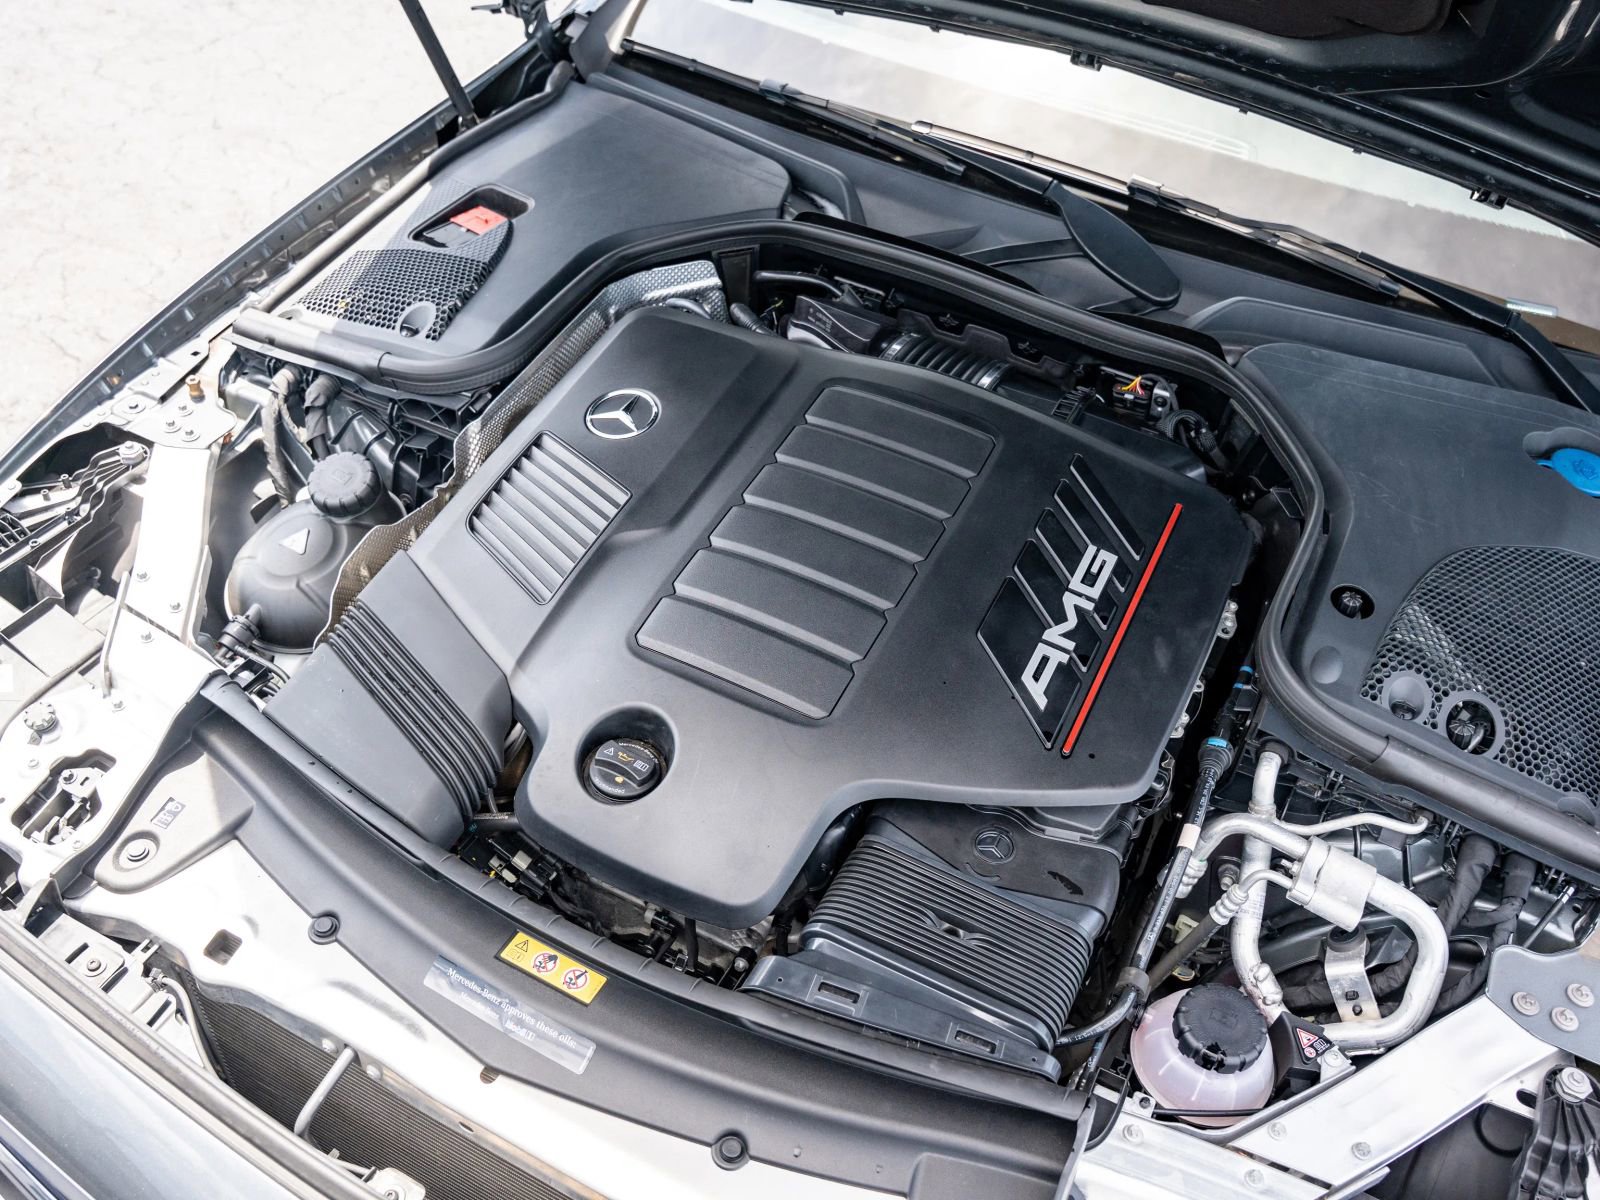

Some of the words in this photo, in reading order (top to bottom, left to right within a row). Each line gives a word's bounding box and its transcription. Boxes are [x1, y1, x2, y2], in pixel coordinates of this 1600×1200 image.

[1021, 544, 1118, 711] AMG
[447, 967, 501, 1005] Mercedes-Benz
[501, 1001, 536, 1025] approves
[536, 1020, 559, 1038] these
[559, 1034, 577, 1048] oils:
